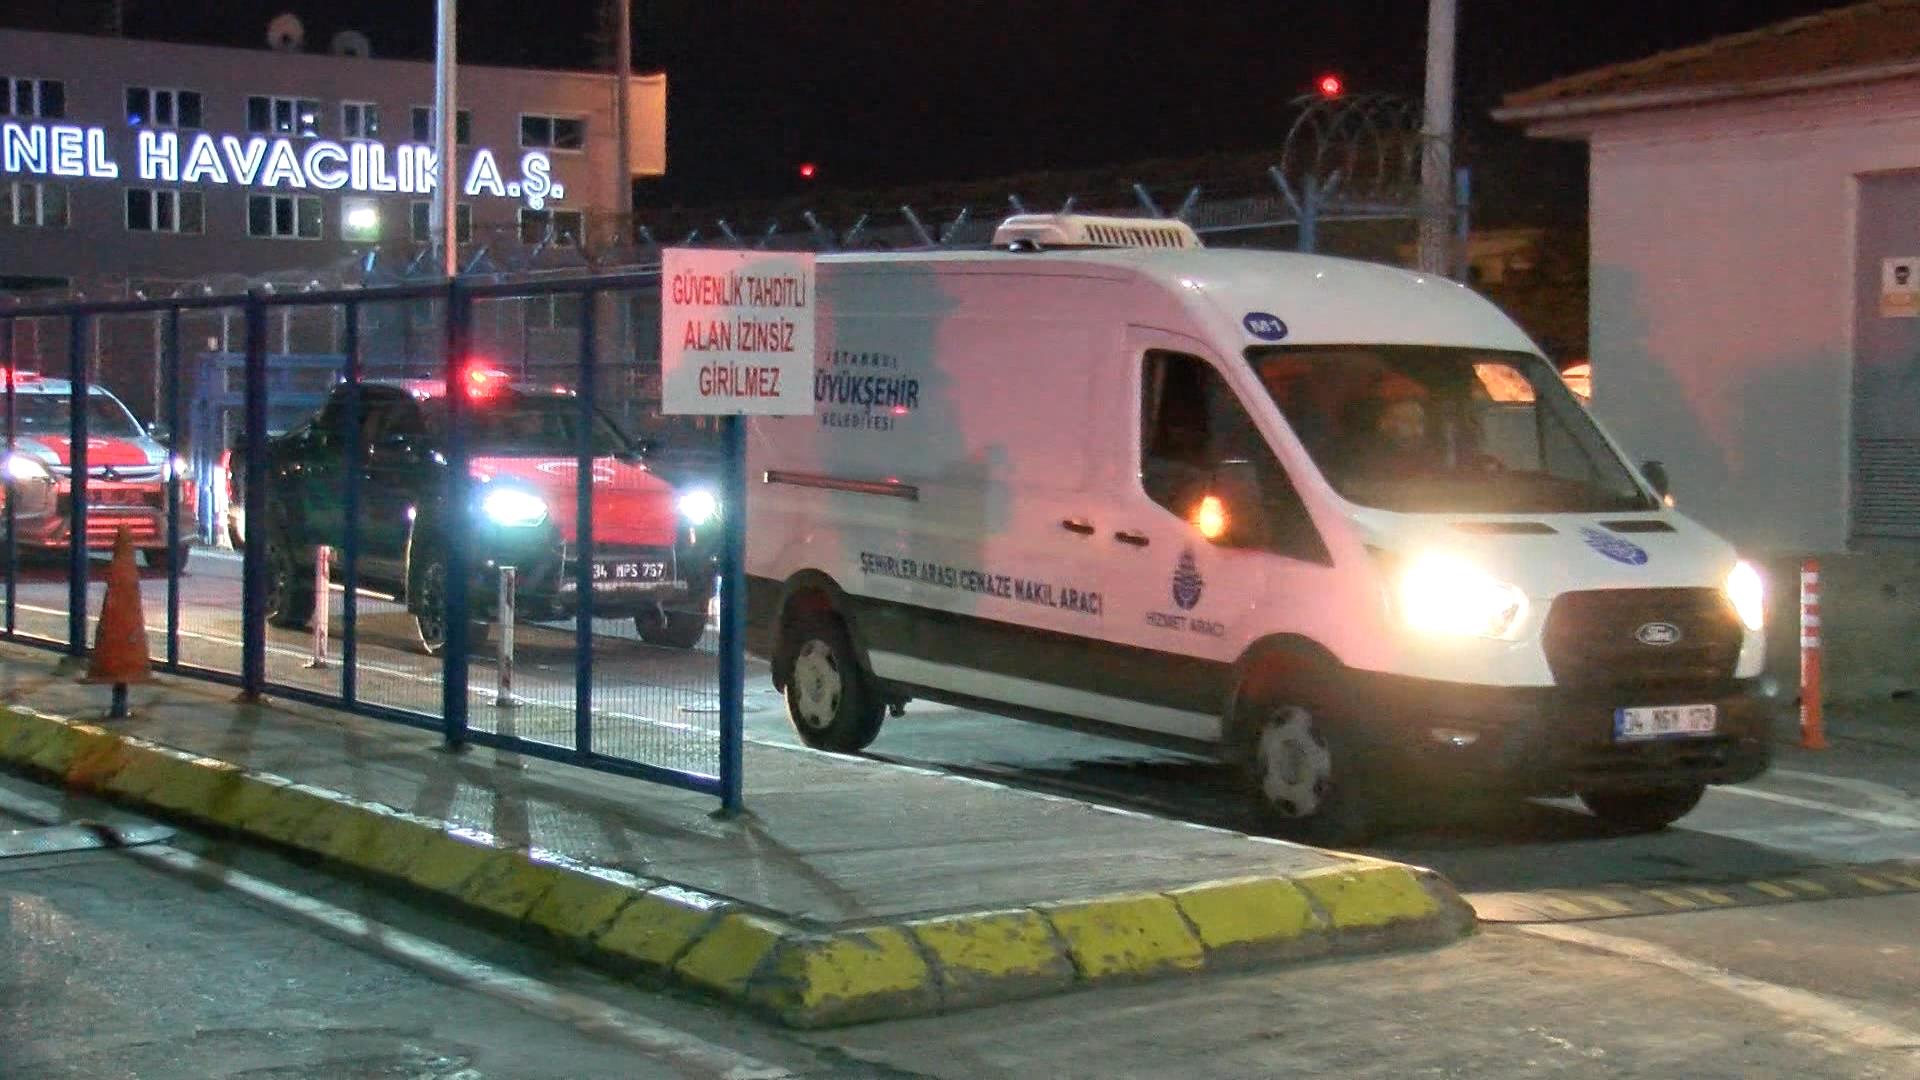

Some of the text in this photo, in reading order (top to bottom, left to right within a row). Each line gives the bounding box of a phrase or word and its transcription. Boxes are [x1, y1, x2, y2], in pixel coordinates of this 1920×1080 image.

[3, 124, 564, 210] NEL HAVACILIK A.Ş.
[672, 268, 807, 307] GÜVENLİK TAHDİTLİ
[683, 315, 794, 352] ALAN İZİNSİZ
[699, 361, 780, 397] GİRİLMEZ
[814, 368, 919, 415] ÜYÜKŞEHİR
